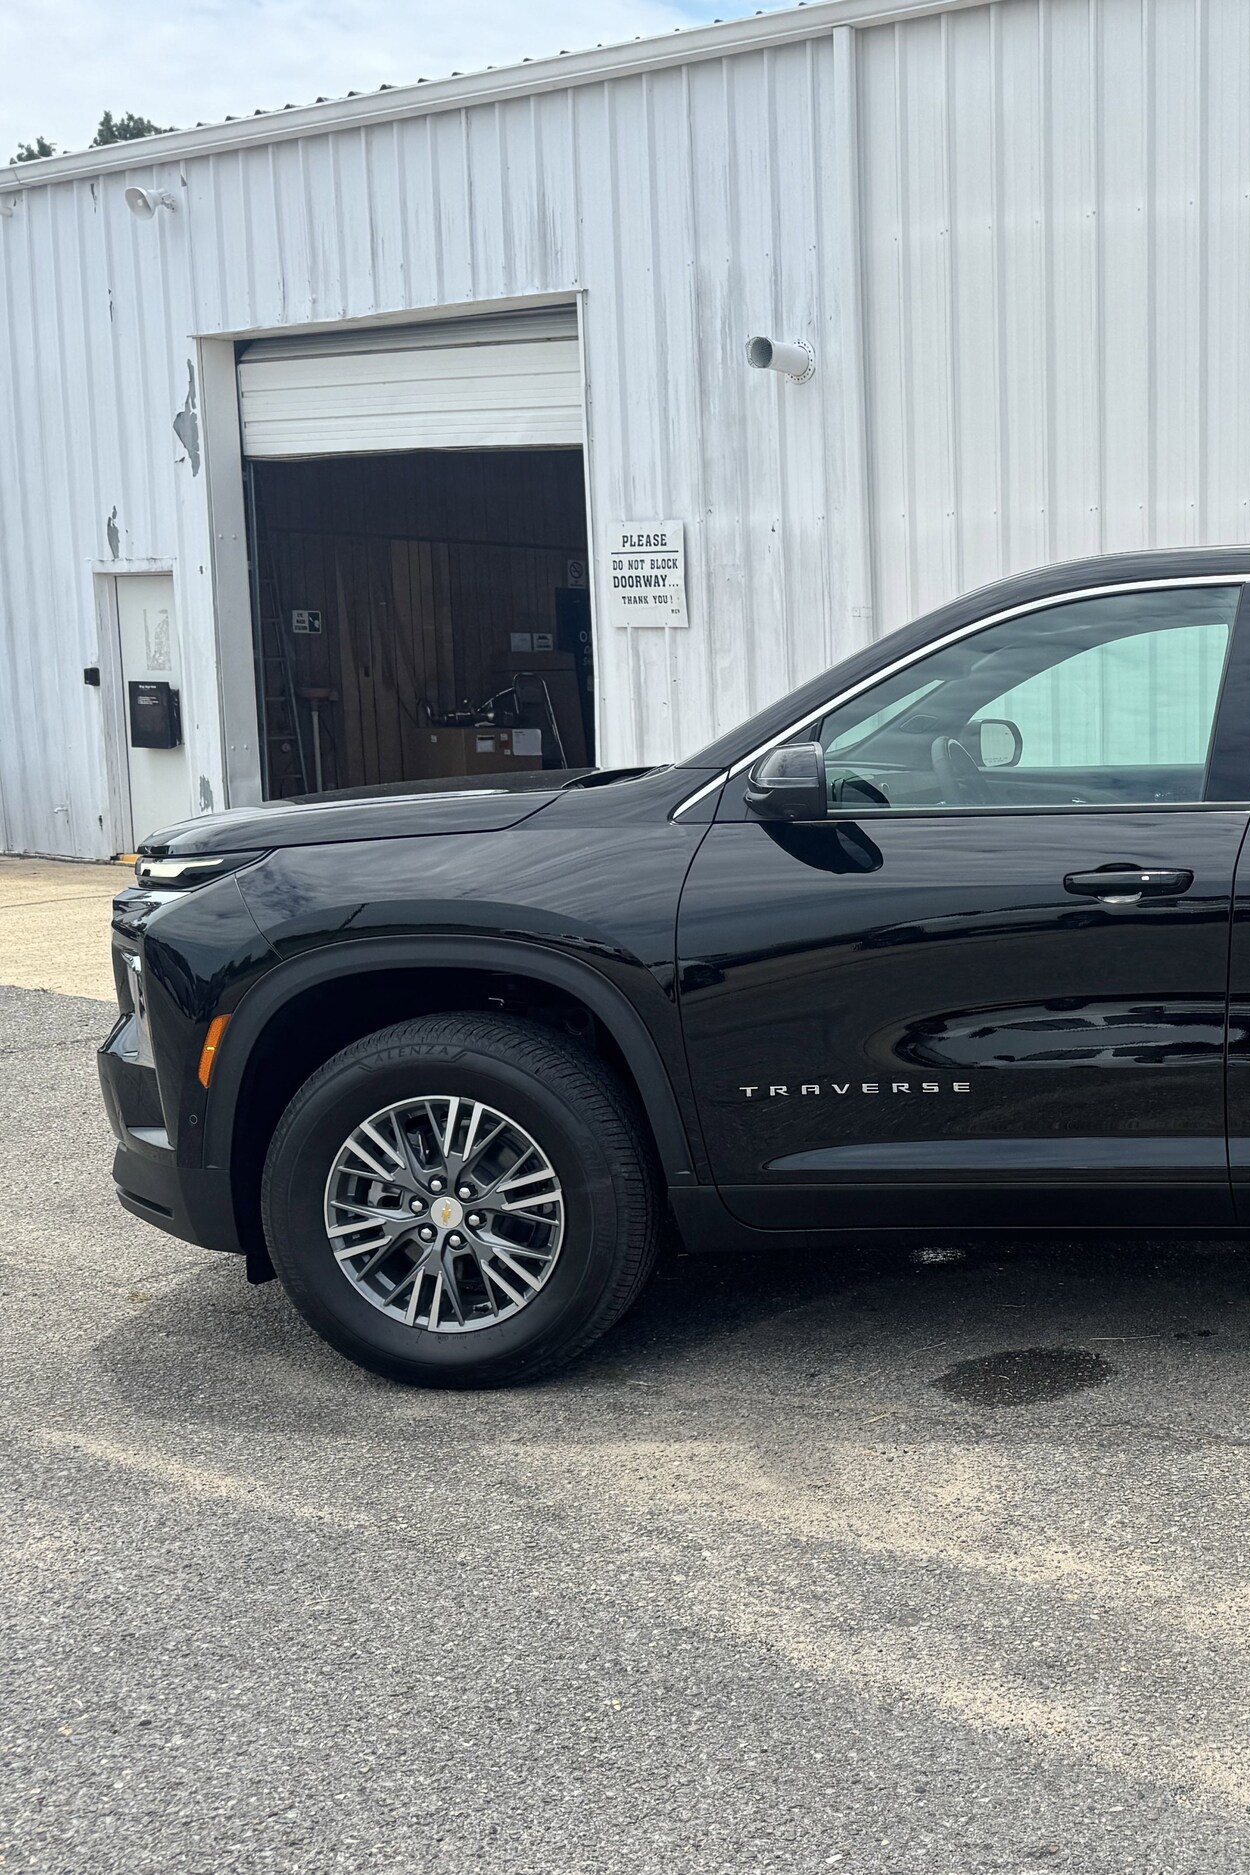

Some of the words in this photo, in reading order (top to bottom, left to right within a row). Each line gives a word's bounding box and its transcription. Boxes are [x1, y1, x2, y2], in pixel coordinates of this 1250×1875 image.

[622, 533, 667, 548] PLEASE
[612, 560, 624, 571] DO
[628, 559, 645, 571] NOT
[650, 558, 678, 570] BLOCK
[612, 574, 679, 589] DOORWAY...
[621, 595, 649, 605] THANK
[374, 1045, 449, 1064] ALENZA
[739, 1082, 970, 1097] TRAVERSE
